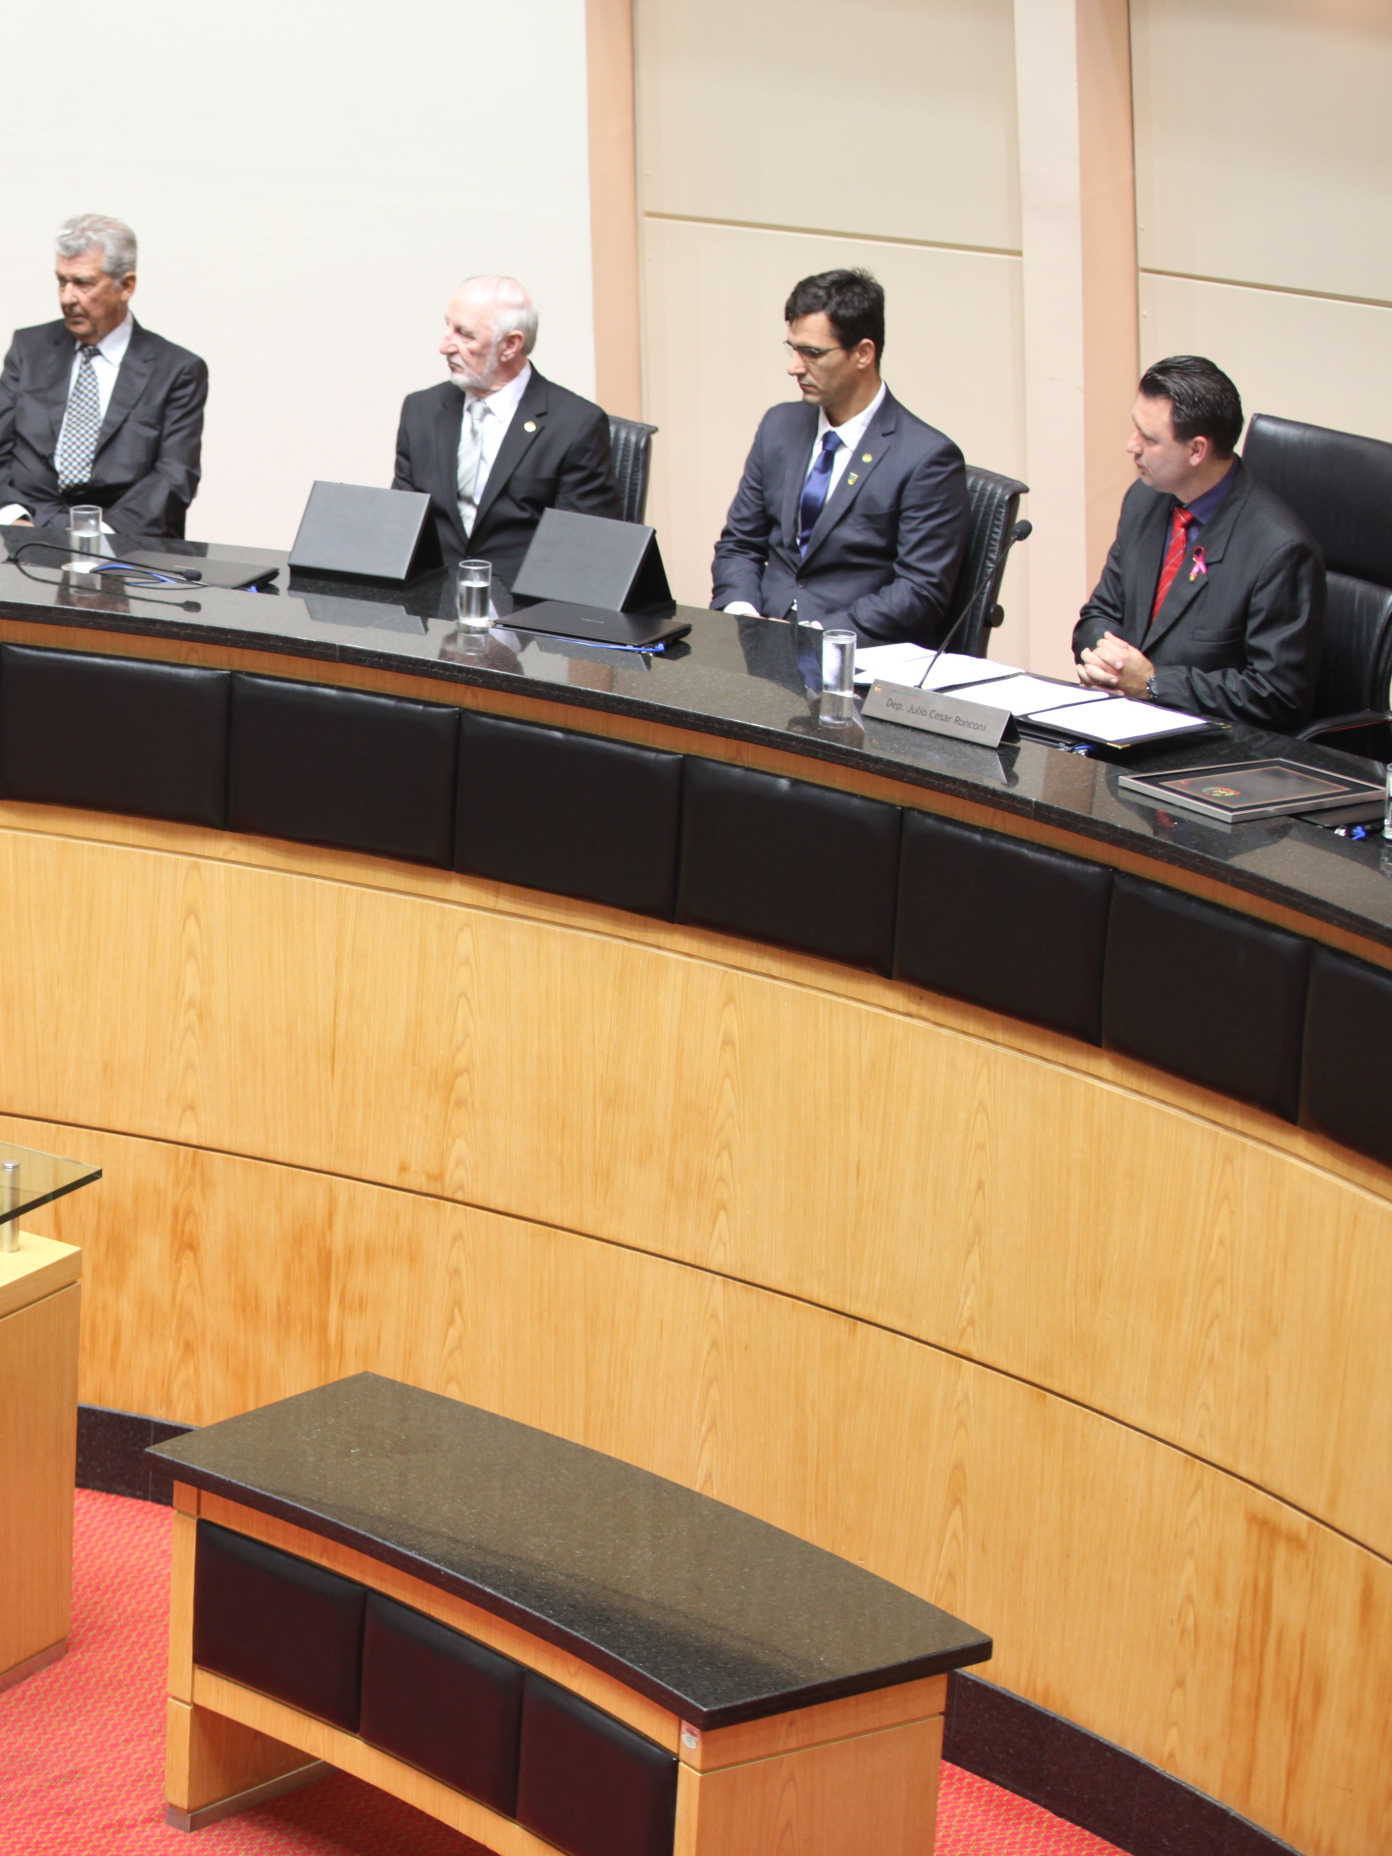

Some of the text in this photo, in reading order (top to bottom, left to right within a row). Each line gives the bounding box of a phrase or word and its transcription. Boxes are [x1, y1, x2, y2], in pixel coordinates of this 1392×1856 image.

[886, 698, 904, 712] Dep.
[929, 709, 953, 723] Cesar
[954, 716, 988, 732] Ronconi
